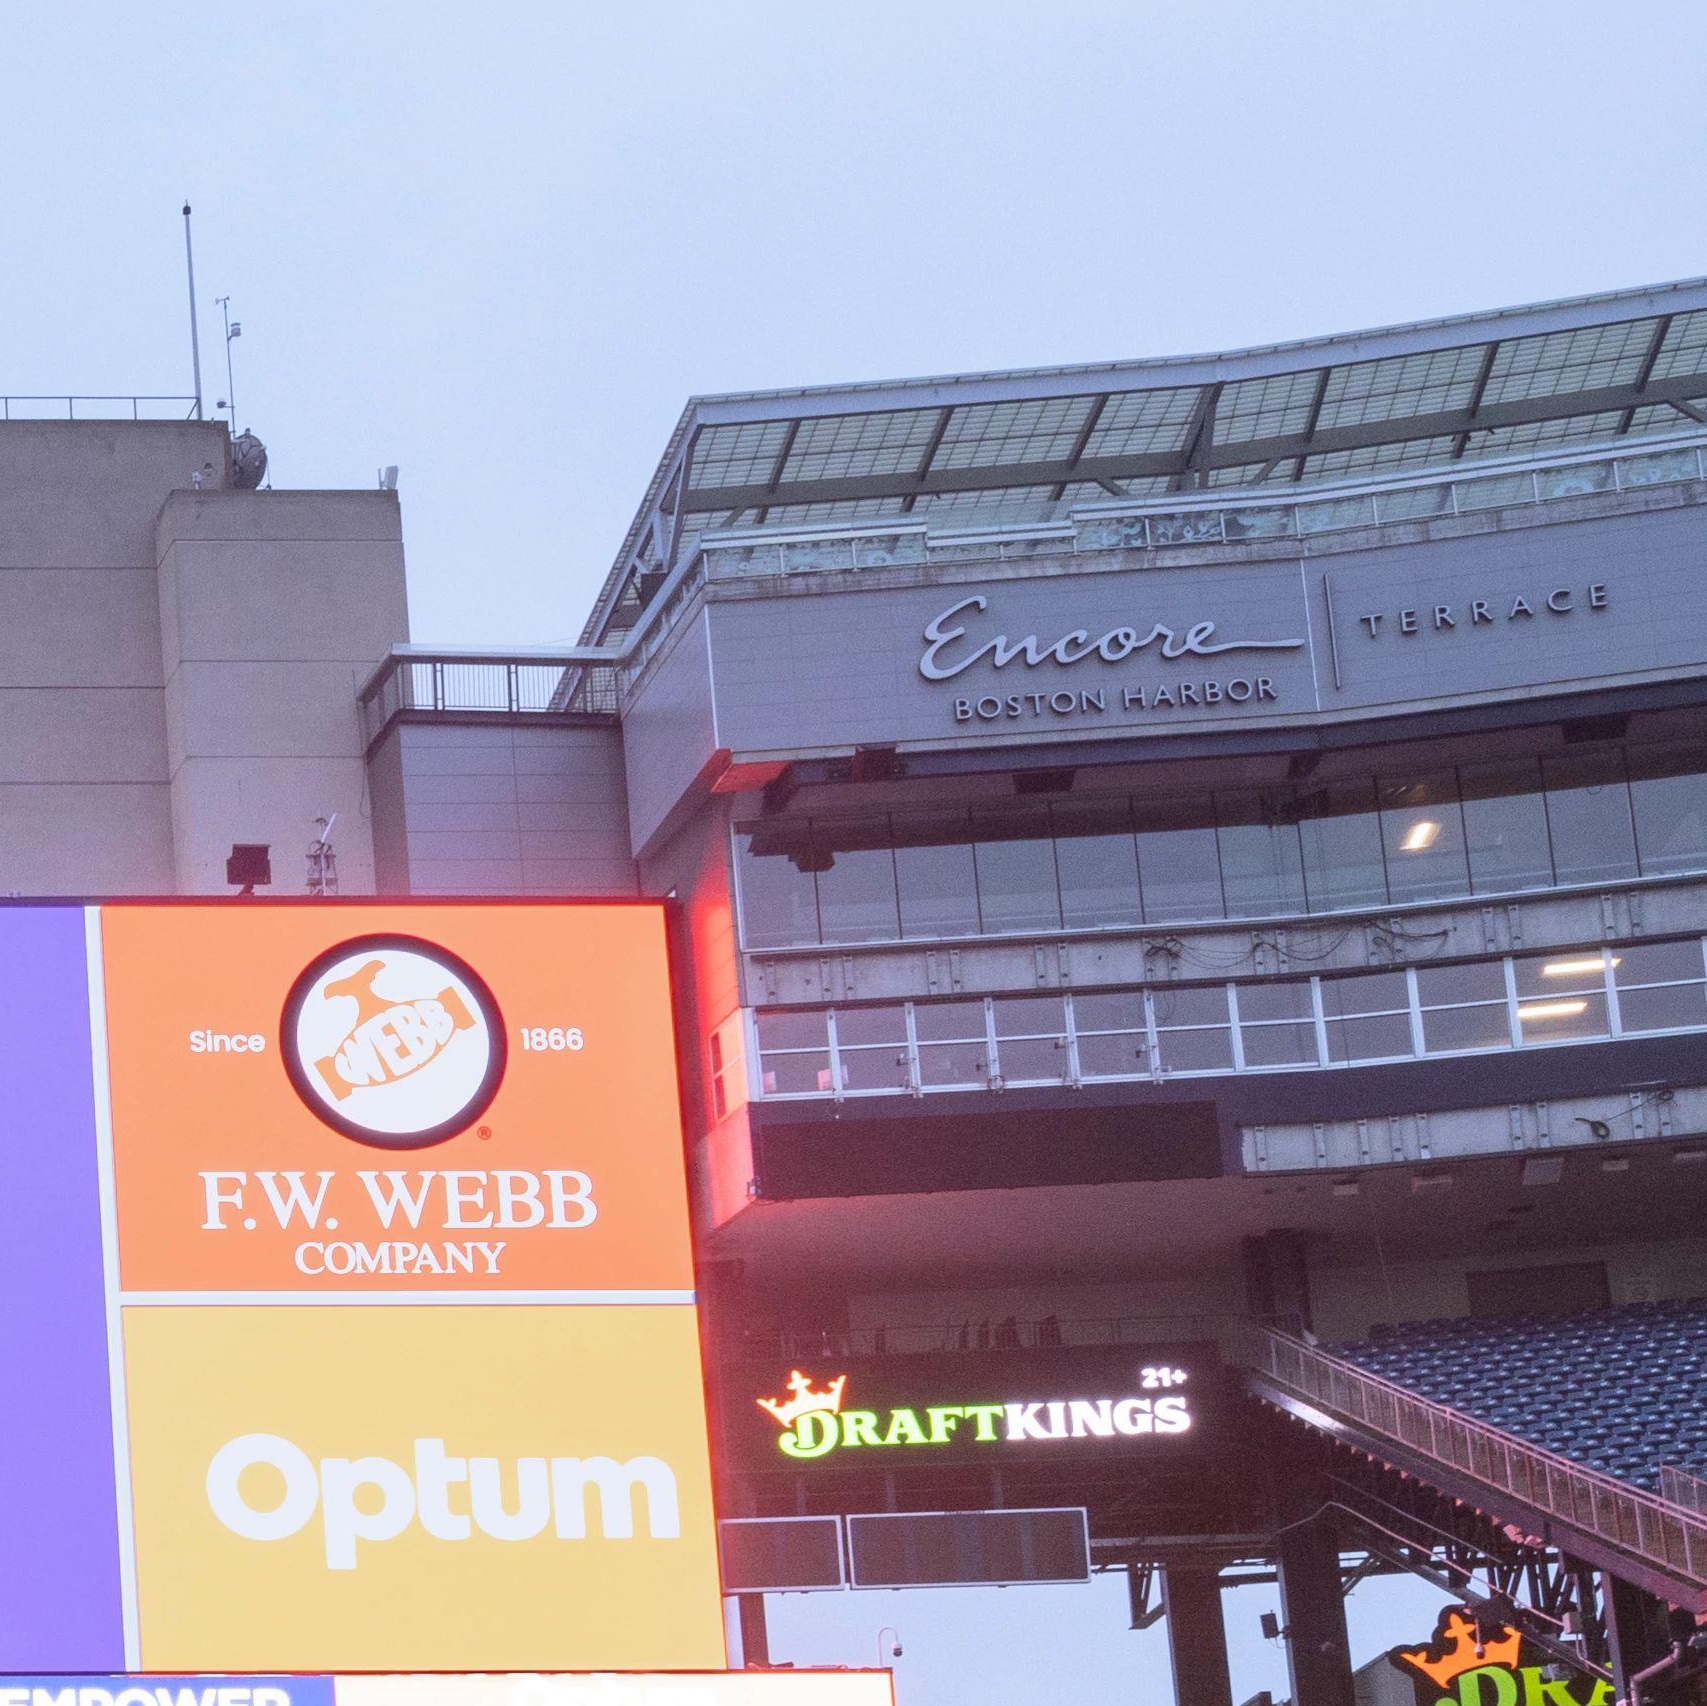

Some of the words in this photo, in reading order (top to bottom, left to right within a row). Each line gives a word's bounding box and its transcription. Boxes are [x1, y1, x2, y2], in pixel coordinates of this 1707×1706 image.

[919, 595, 1306, 681] Encore
[1360, 583, 1609, 638] TERRACE
[954, 688, 1105, 721] BOSTON
[1122, 676, 1279, 711] HARBOR
[188, 1030, 266, 1053] Since
[334, 998, 456, 1087] WEBB
[519, 1026, 585, 1052] 1866
[197, 1170, 338, 1231] F.W.
[356, 1170, 599, 1230] WEBB
[293, 1241, 506, 1275] COMPANY
[1140, 1366, 1188, 1389] 21+
[779, 1396, 1192, 1459] DRAFTKINGS
[205, 1432, 681, 1571] Optum
